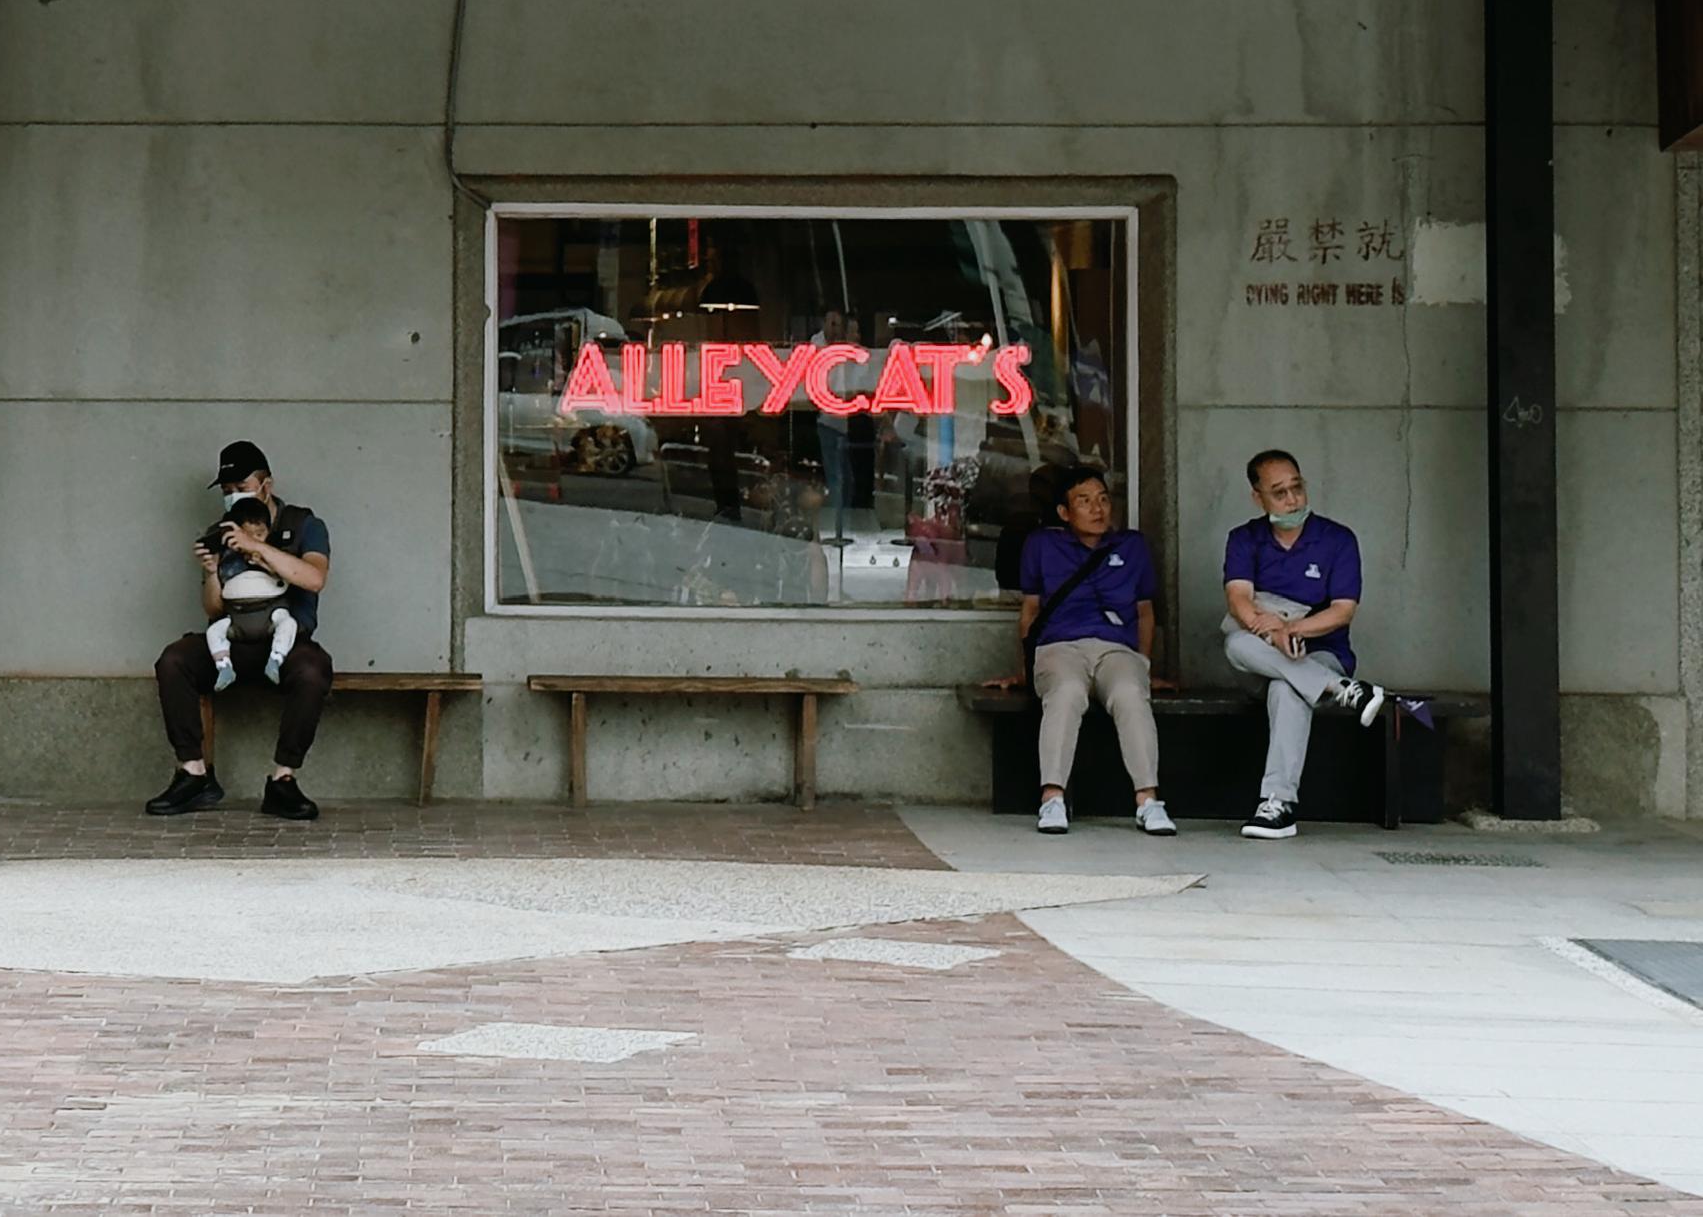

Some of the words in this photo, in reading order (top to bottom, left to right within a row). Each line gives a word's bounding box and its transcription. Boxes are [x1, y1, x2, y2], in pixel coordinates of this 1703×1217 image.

[1248, 216, 1405, 266] 嚴禁就
[1245, 281, 1289, 307] DYING
[1296, 281, 1341, 307] RIGHT
[1344, 281, 1385, 307] HERE
[560, 334, 1032, 416] ALLEYCAT'S
